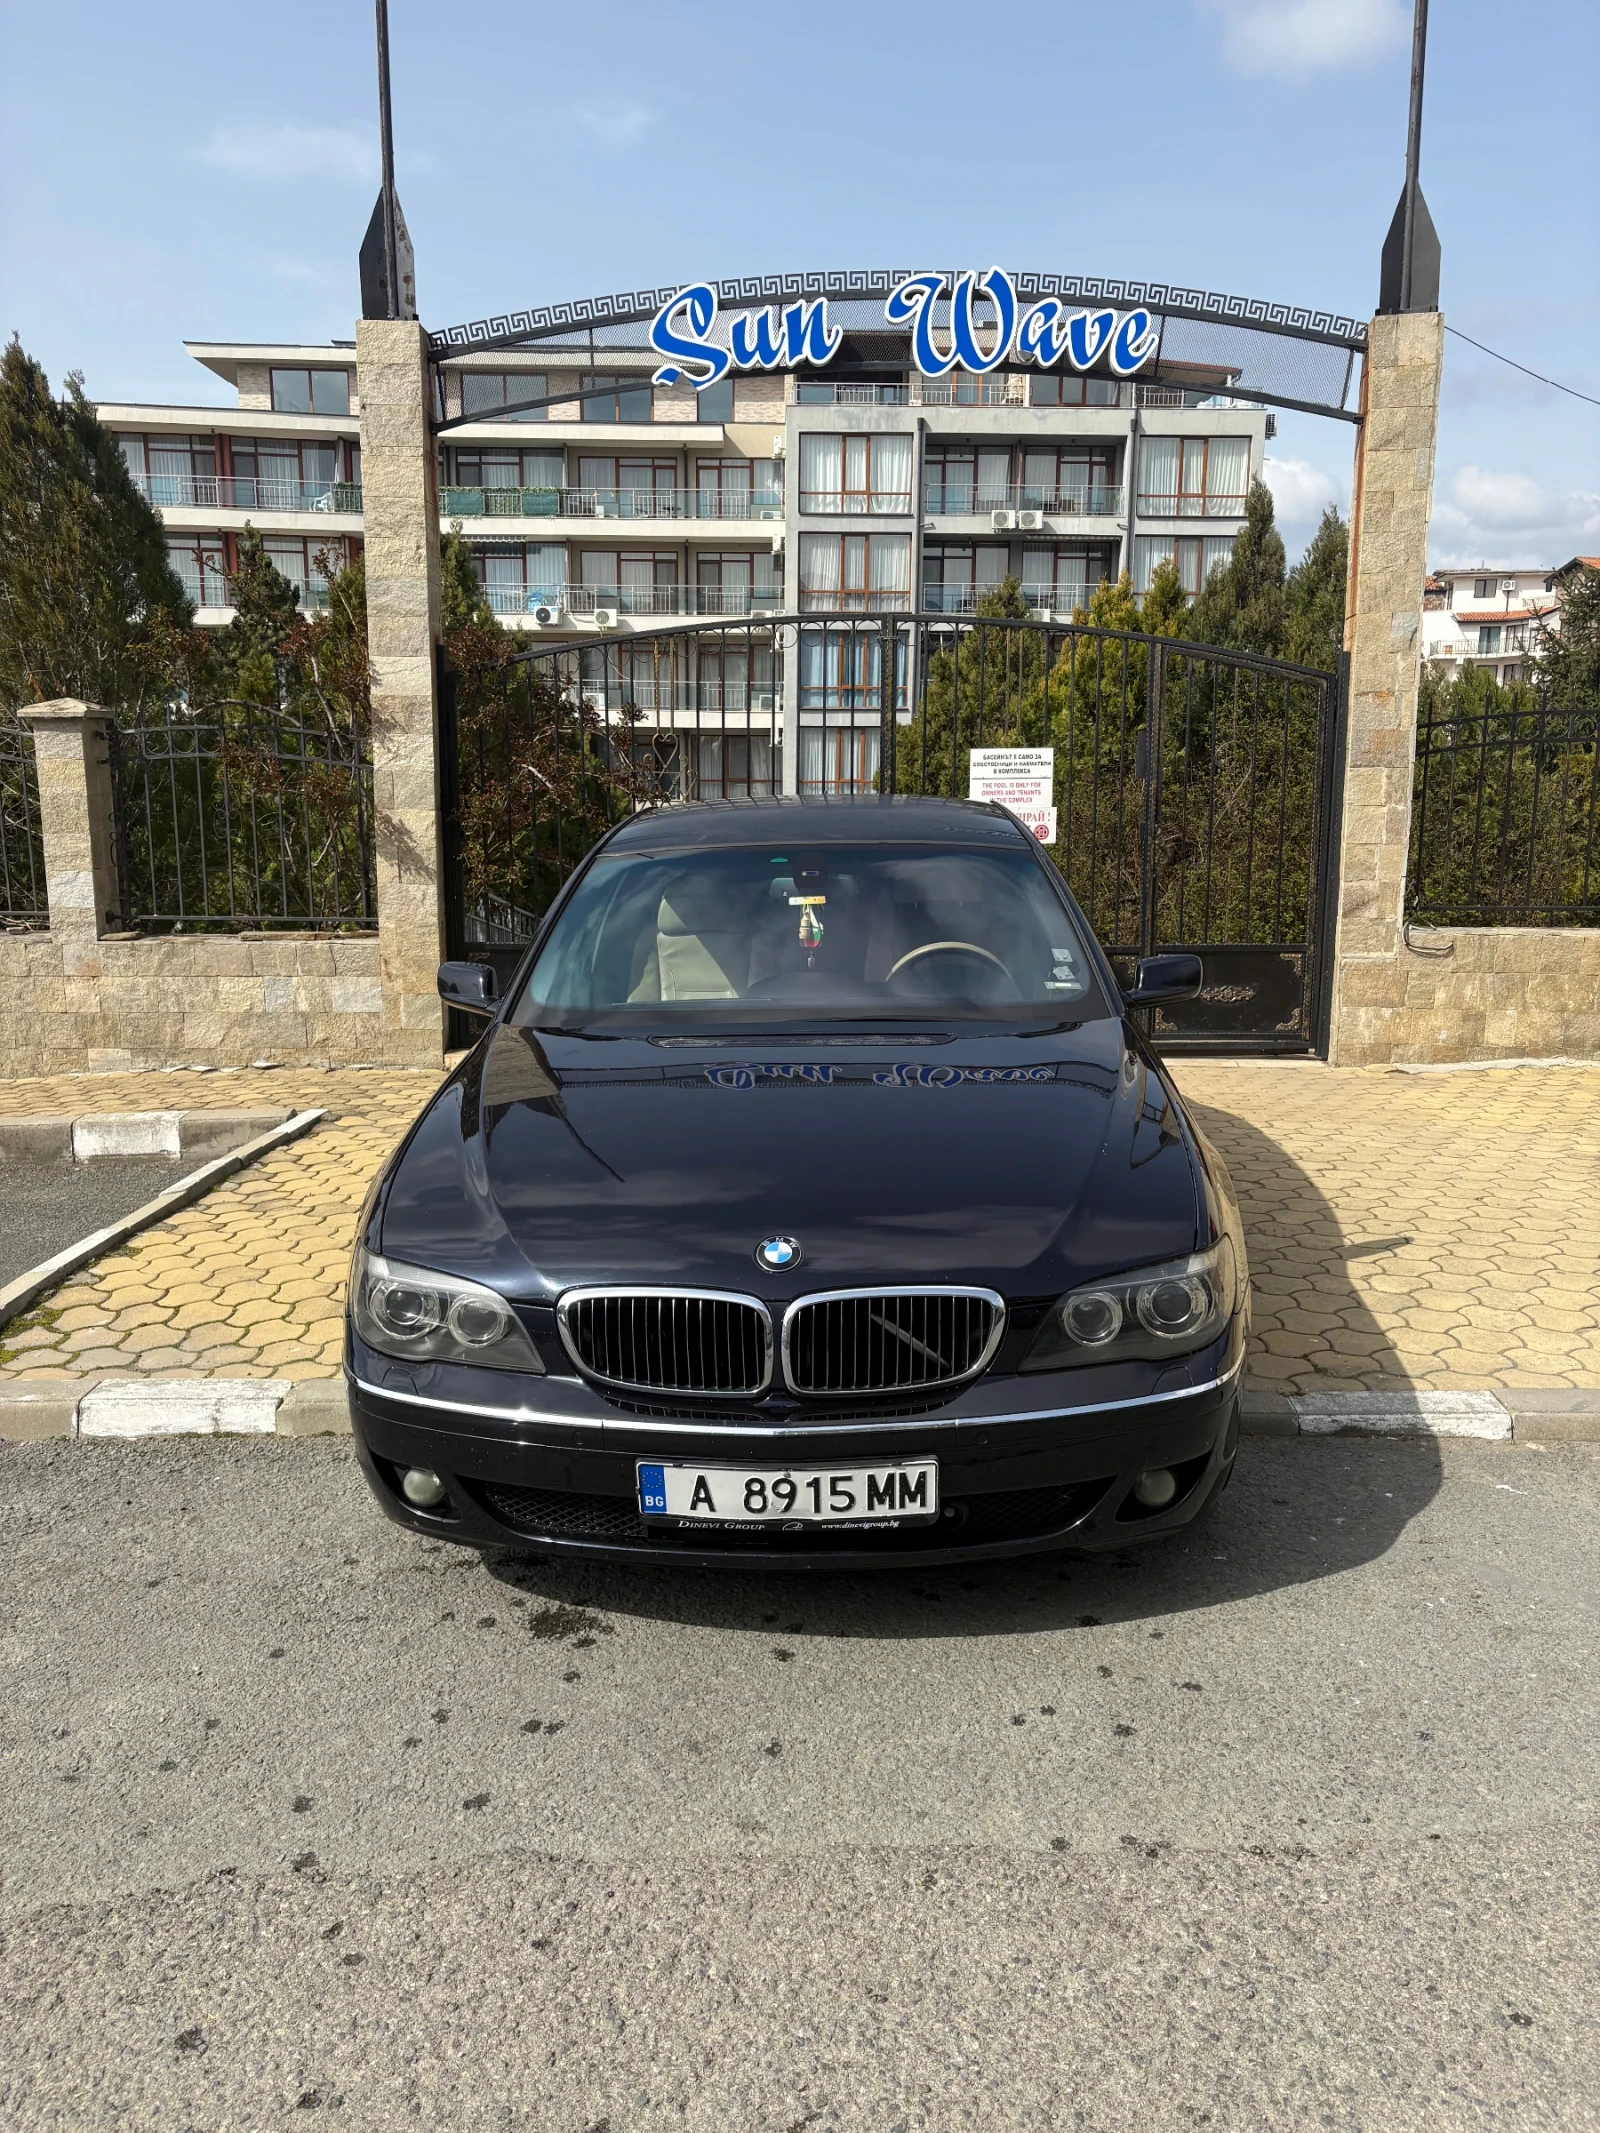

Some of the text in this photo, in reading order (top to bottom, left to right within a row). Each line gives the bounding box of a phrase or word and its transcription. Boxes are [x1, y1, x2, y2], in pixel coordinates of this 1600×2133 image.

[649, 265, 1160, 393] Sun Wave
[762, 1237, 798, 1248] BMW
[689, 1471, 927, 1514] A 8915 MM
[645, 1494, 664, 1508] BG
[821, 1519, 900, 1530] www.dinevigroup.bg
